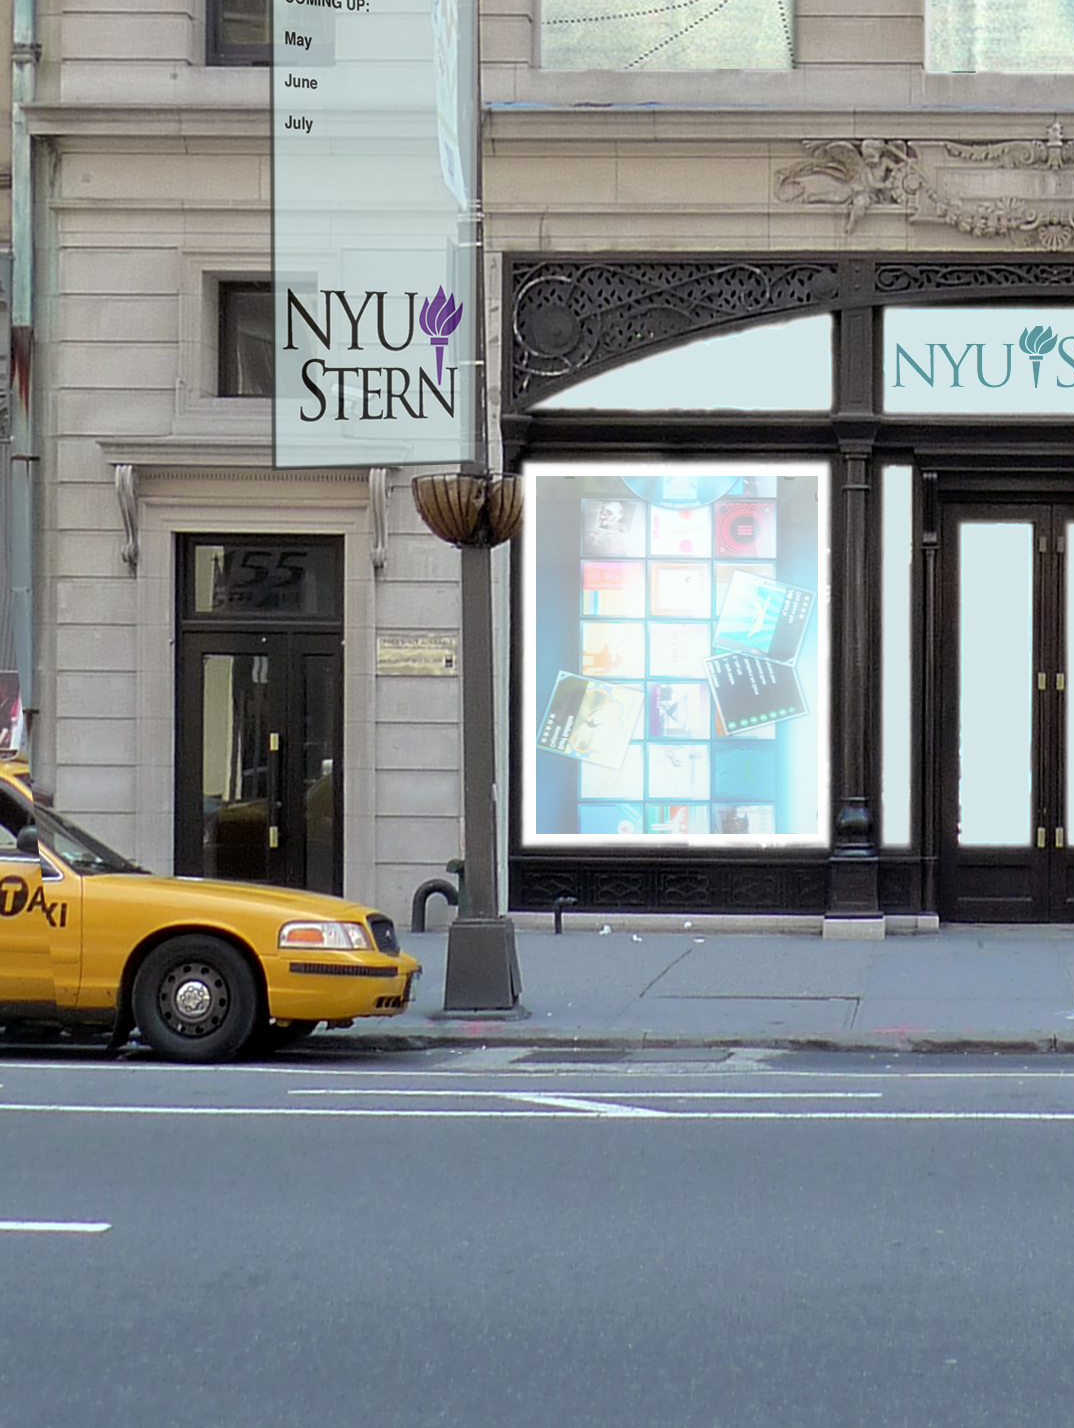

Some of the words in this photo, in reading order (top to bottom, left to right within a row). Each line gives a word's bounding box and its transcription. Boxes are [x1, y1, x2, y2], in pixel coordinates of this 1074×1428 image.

[285, 31, 312, 50] May
[285, 73, 318, 90] June
[285, 115, 313, 133] July
[283, 288, 418, 351] NYU
[892, 342, 1015, 388] NYU
[300, 358, 458, 422] STERN
